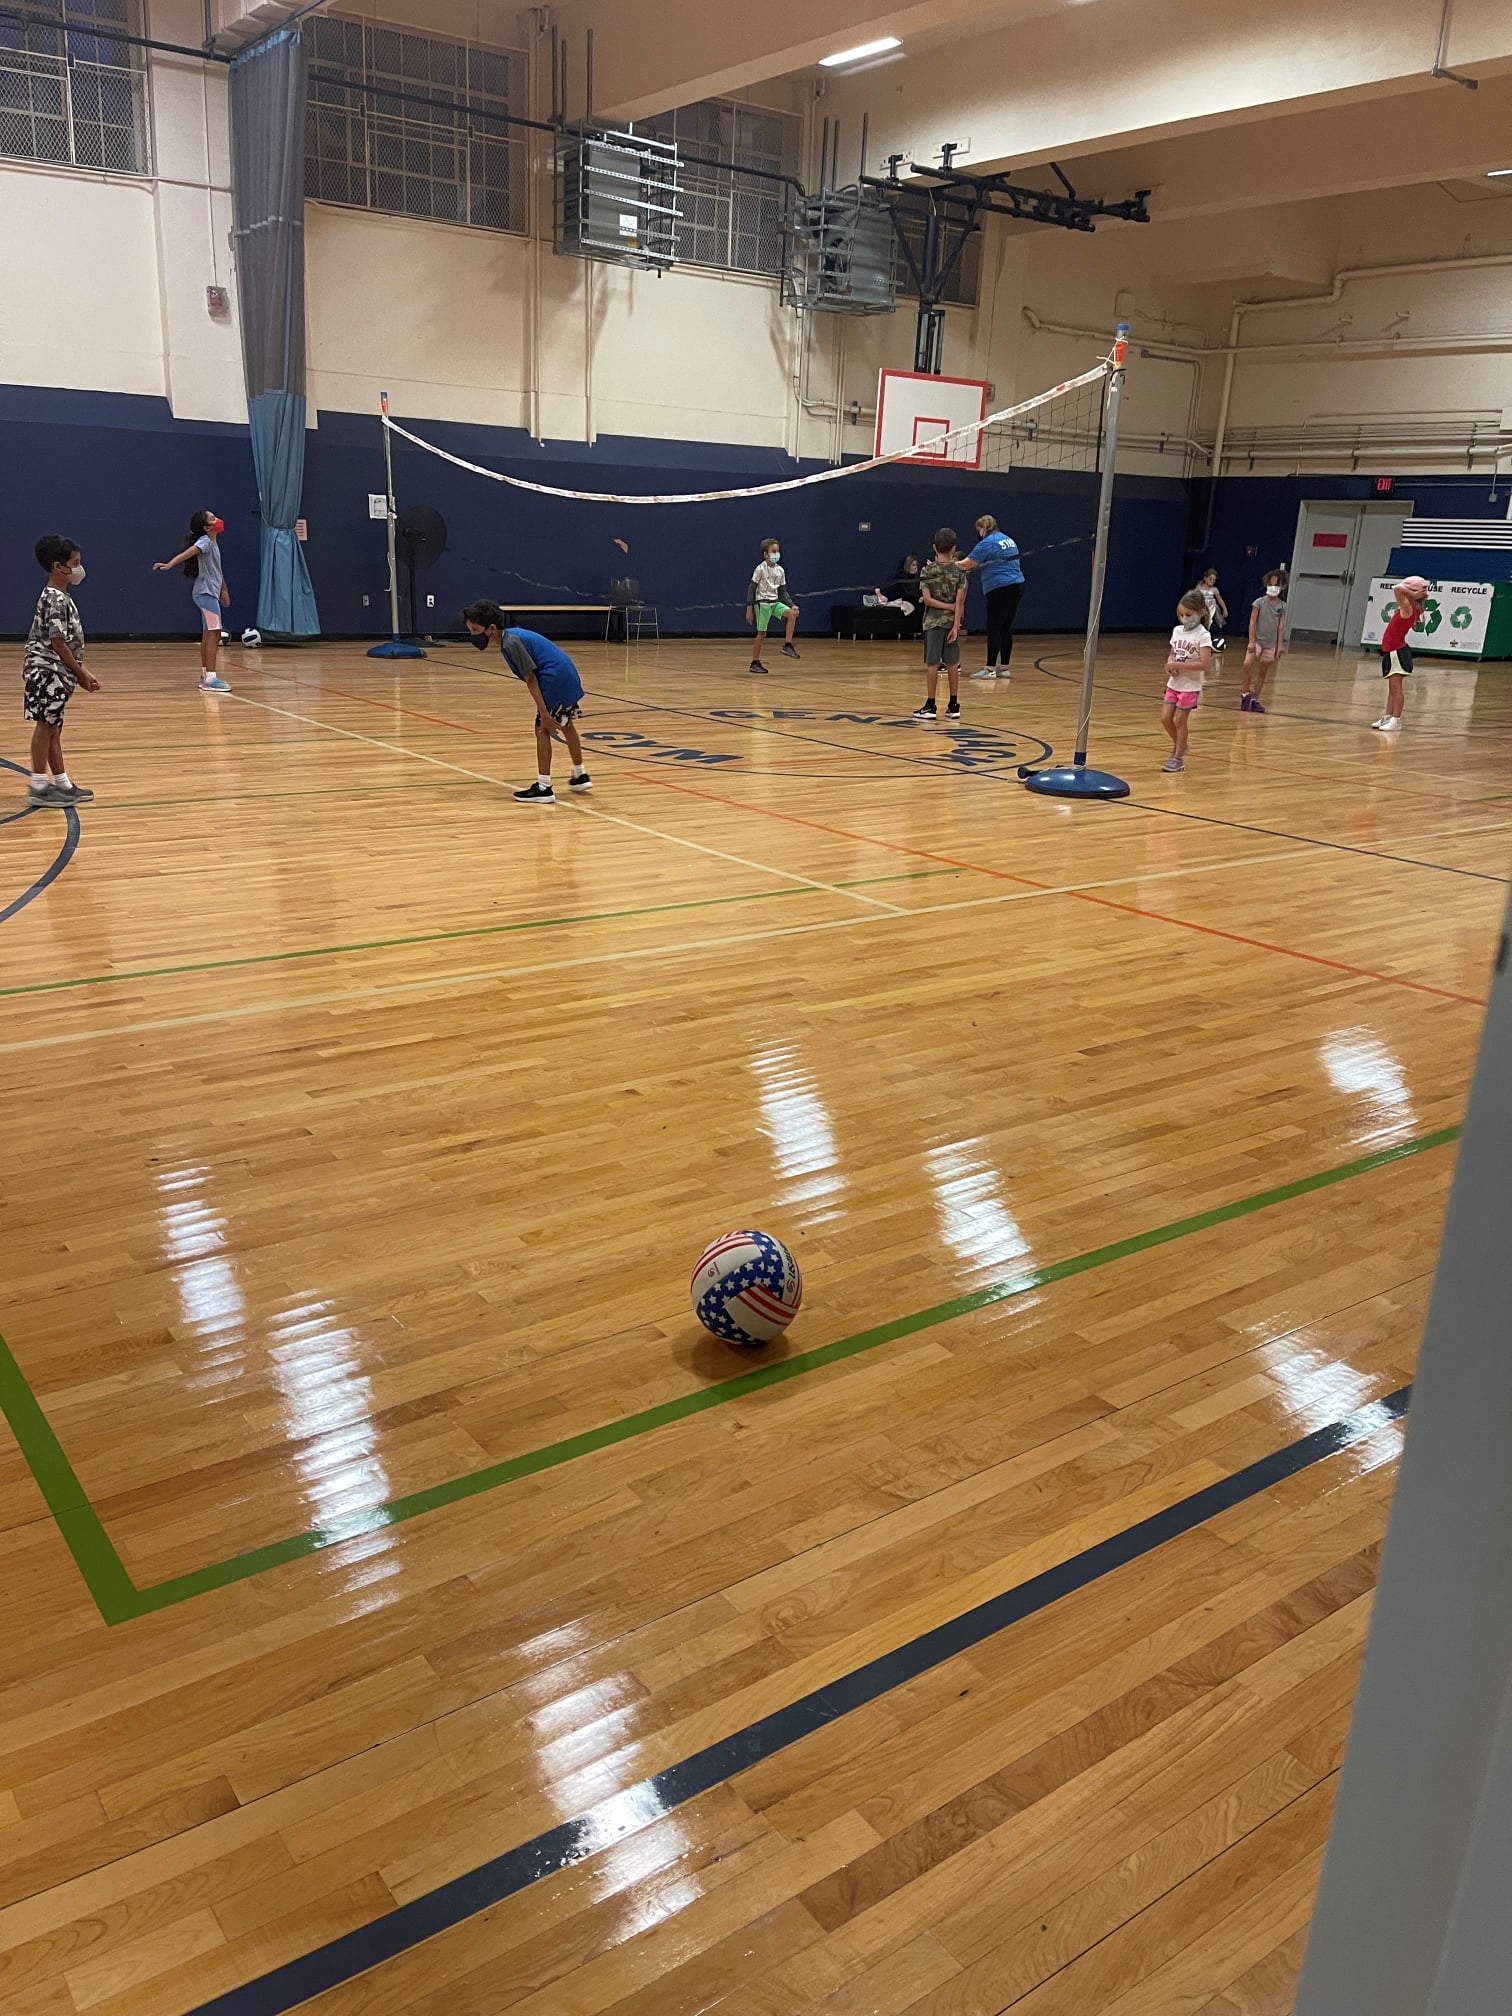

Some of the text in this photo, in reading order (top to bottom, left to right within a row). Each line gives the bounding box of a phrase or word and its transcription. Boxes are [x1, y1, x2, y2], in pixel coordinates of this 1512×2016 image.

[1377, 478, 1392, 490] EXIT
[1451, 586, 1487, 594] RECYCLE
[580, 731, 745, 764] GYM
[709, 710, 1018, 767] GENE MACK
